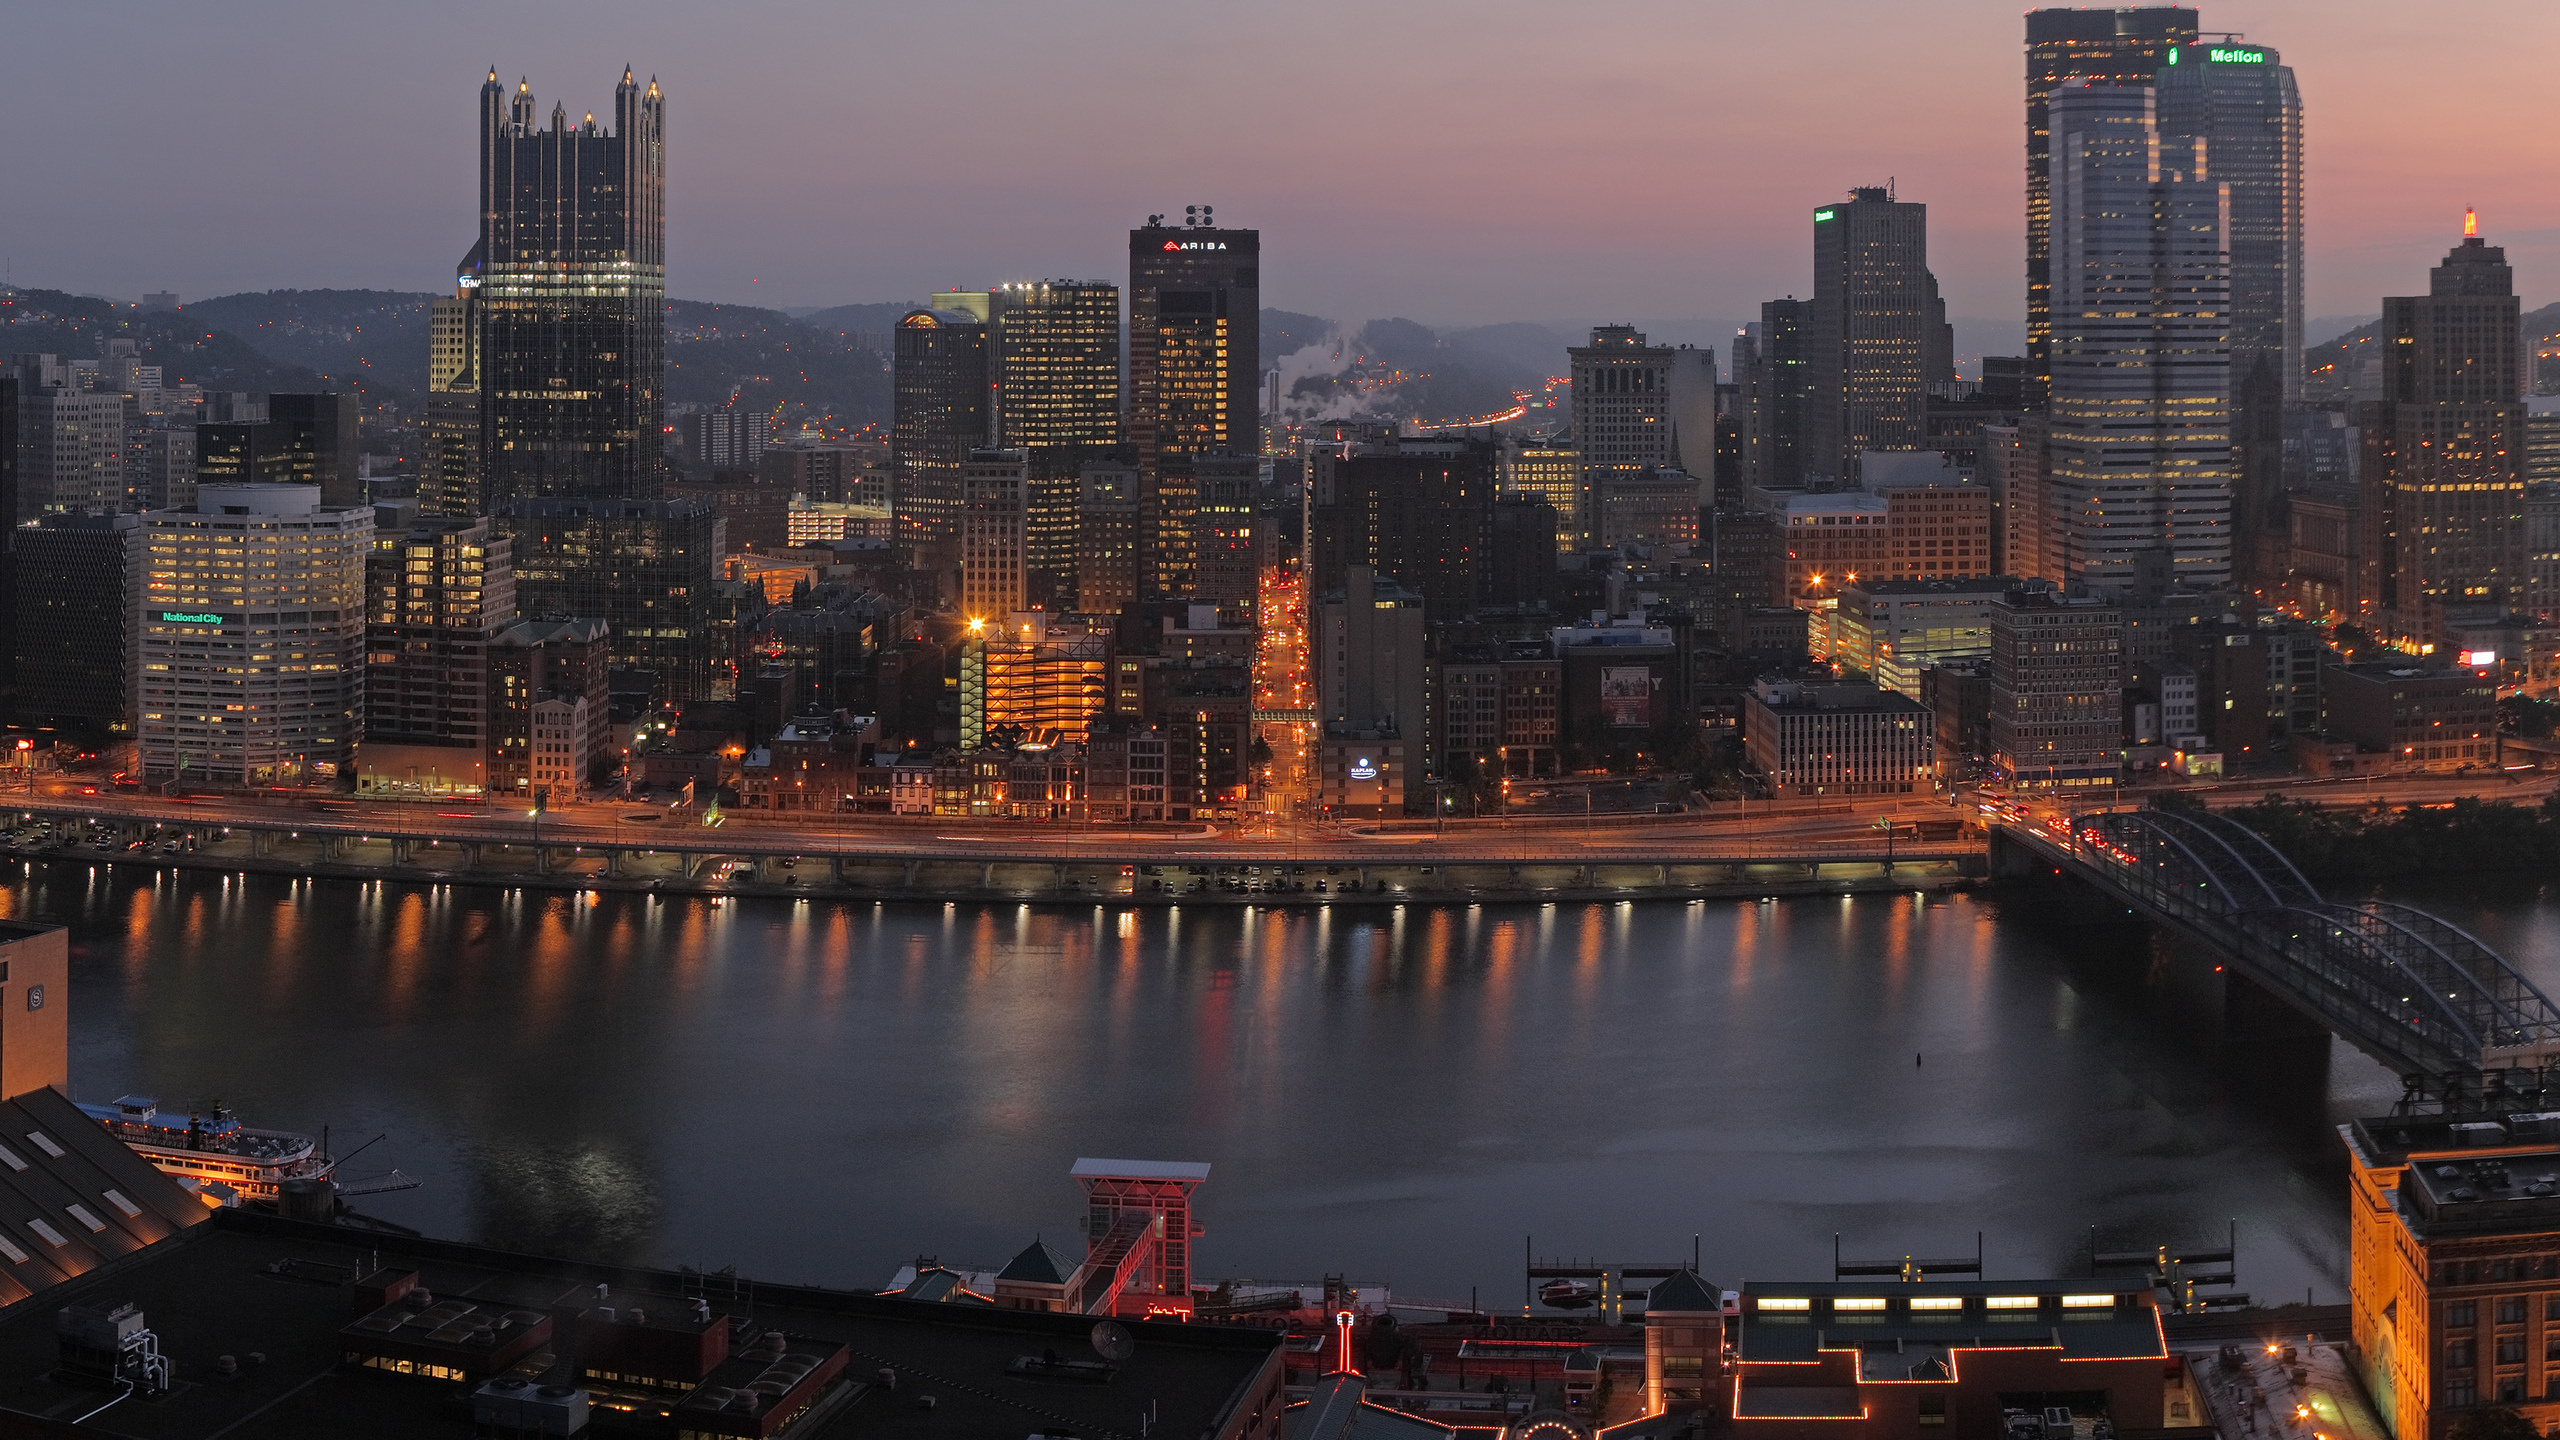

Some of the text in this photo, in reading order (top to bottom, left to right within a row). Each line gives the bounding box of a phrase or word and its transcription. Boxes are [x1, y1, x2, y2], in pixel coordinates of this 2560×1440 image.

[2211, 49, 2264, 64] Mellon
[1180, 242, 1227, 250] ARIBA
[163, 612, 223, 625] National City
[1602, 667, 1614, 680] Y
[1650, 677, 1663, 691] Y
